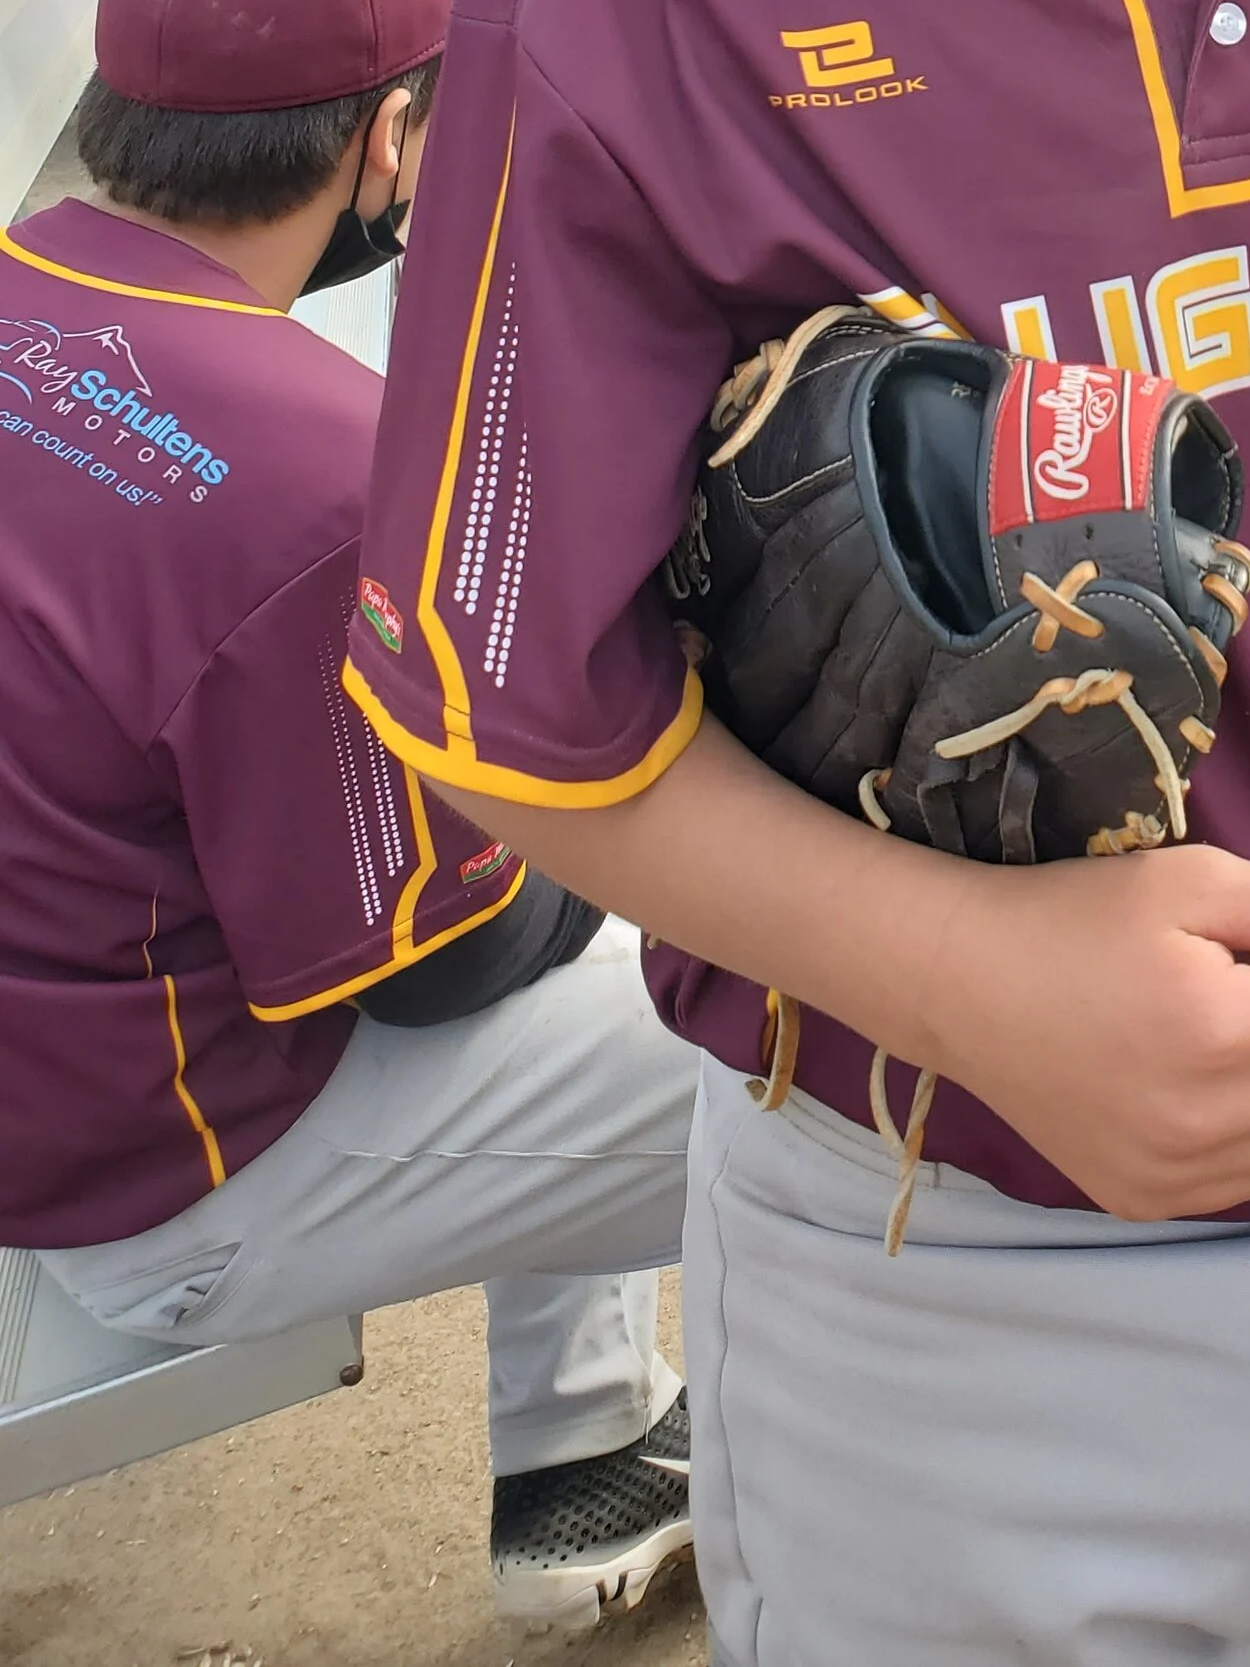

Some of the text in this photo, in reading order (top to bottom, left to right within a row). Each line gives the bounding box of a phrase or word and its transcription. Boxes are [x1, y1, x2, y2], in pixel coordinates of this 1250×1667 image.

[767, 75, 929, 109] PROLOOK
[13, 340, 230, 485] Ray Schultens
[32, 430, 94, 468] count
[88, 463, 118, 485] on
[52, 397, 208, 503] MOTORS
[1034, 364, 1112, 501] Rawling
